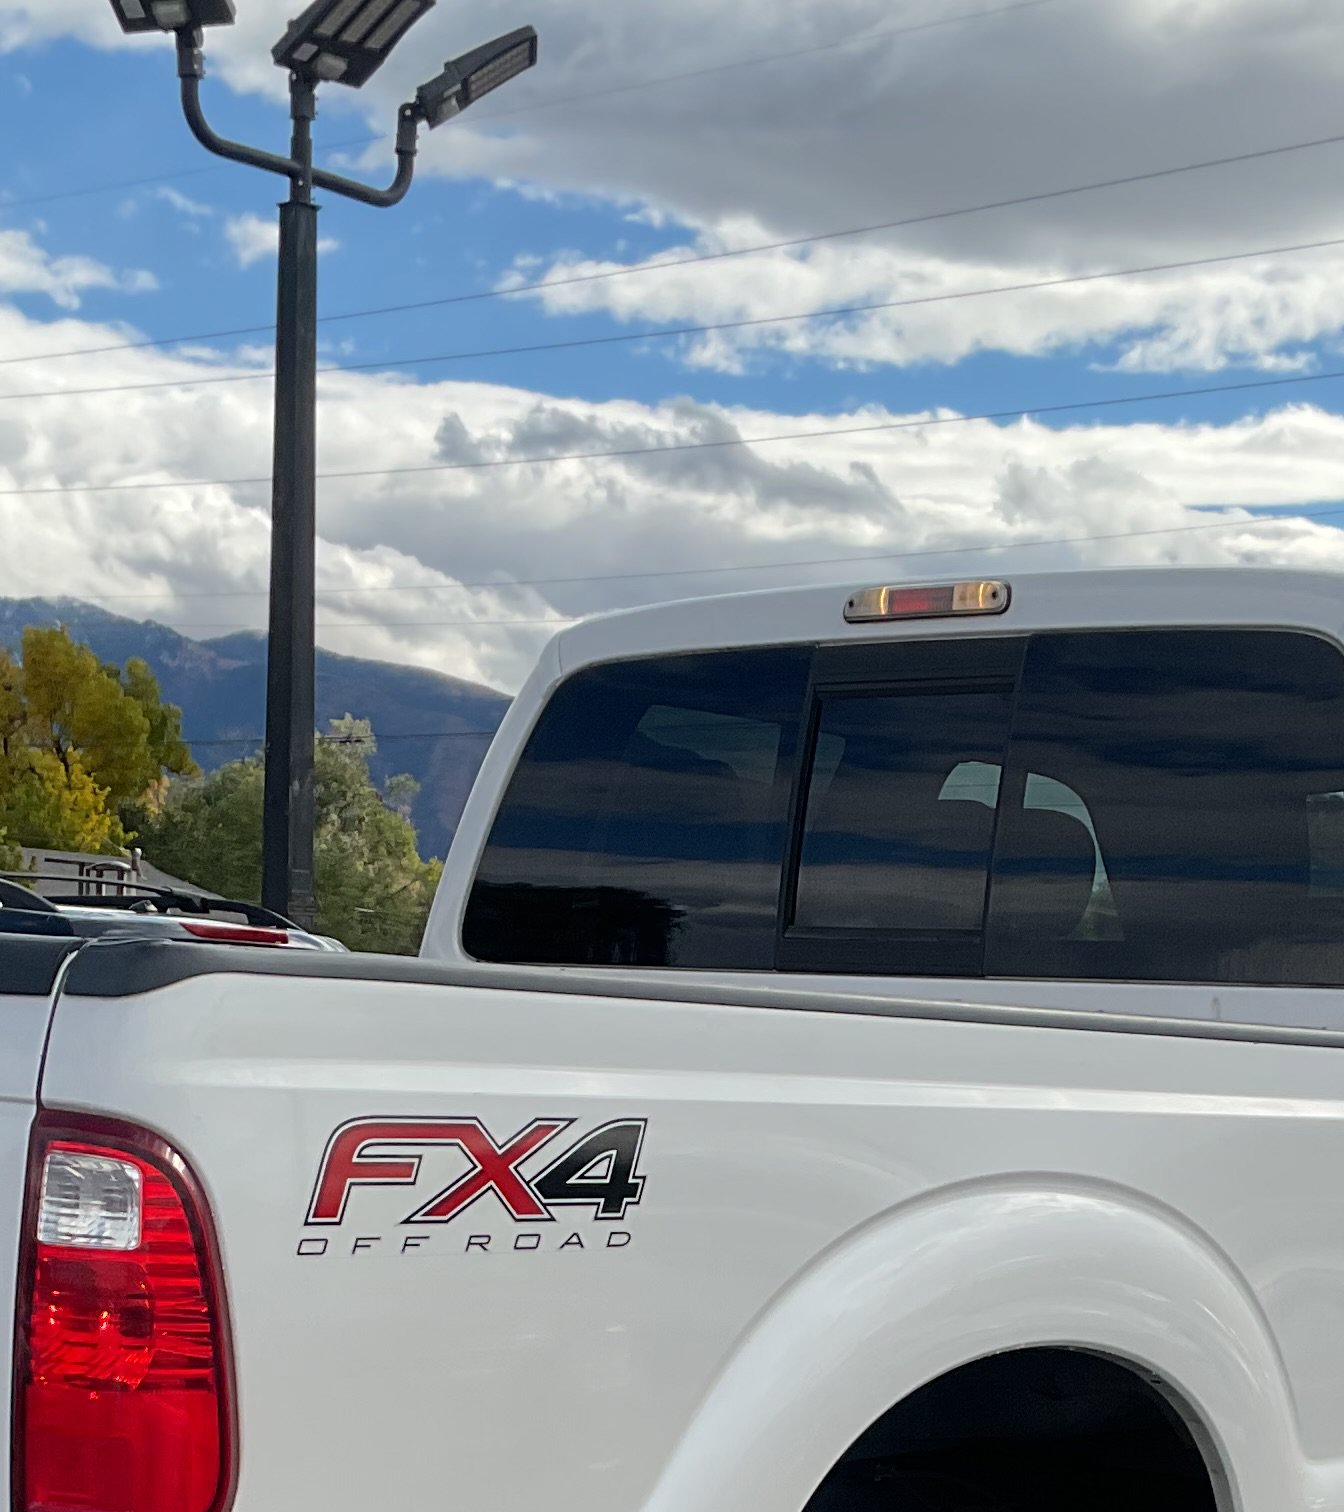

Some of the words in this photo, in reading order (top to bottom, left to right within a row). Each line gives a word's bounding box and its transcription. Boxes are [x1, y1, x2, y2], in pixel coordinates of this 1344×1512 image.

[303, 1115, 648, 1226] FX4
[297, 1235, 431, 1257] OFF
[465, 1231, 632, 1253] ROAD
